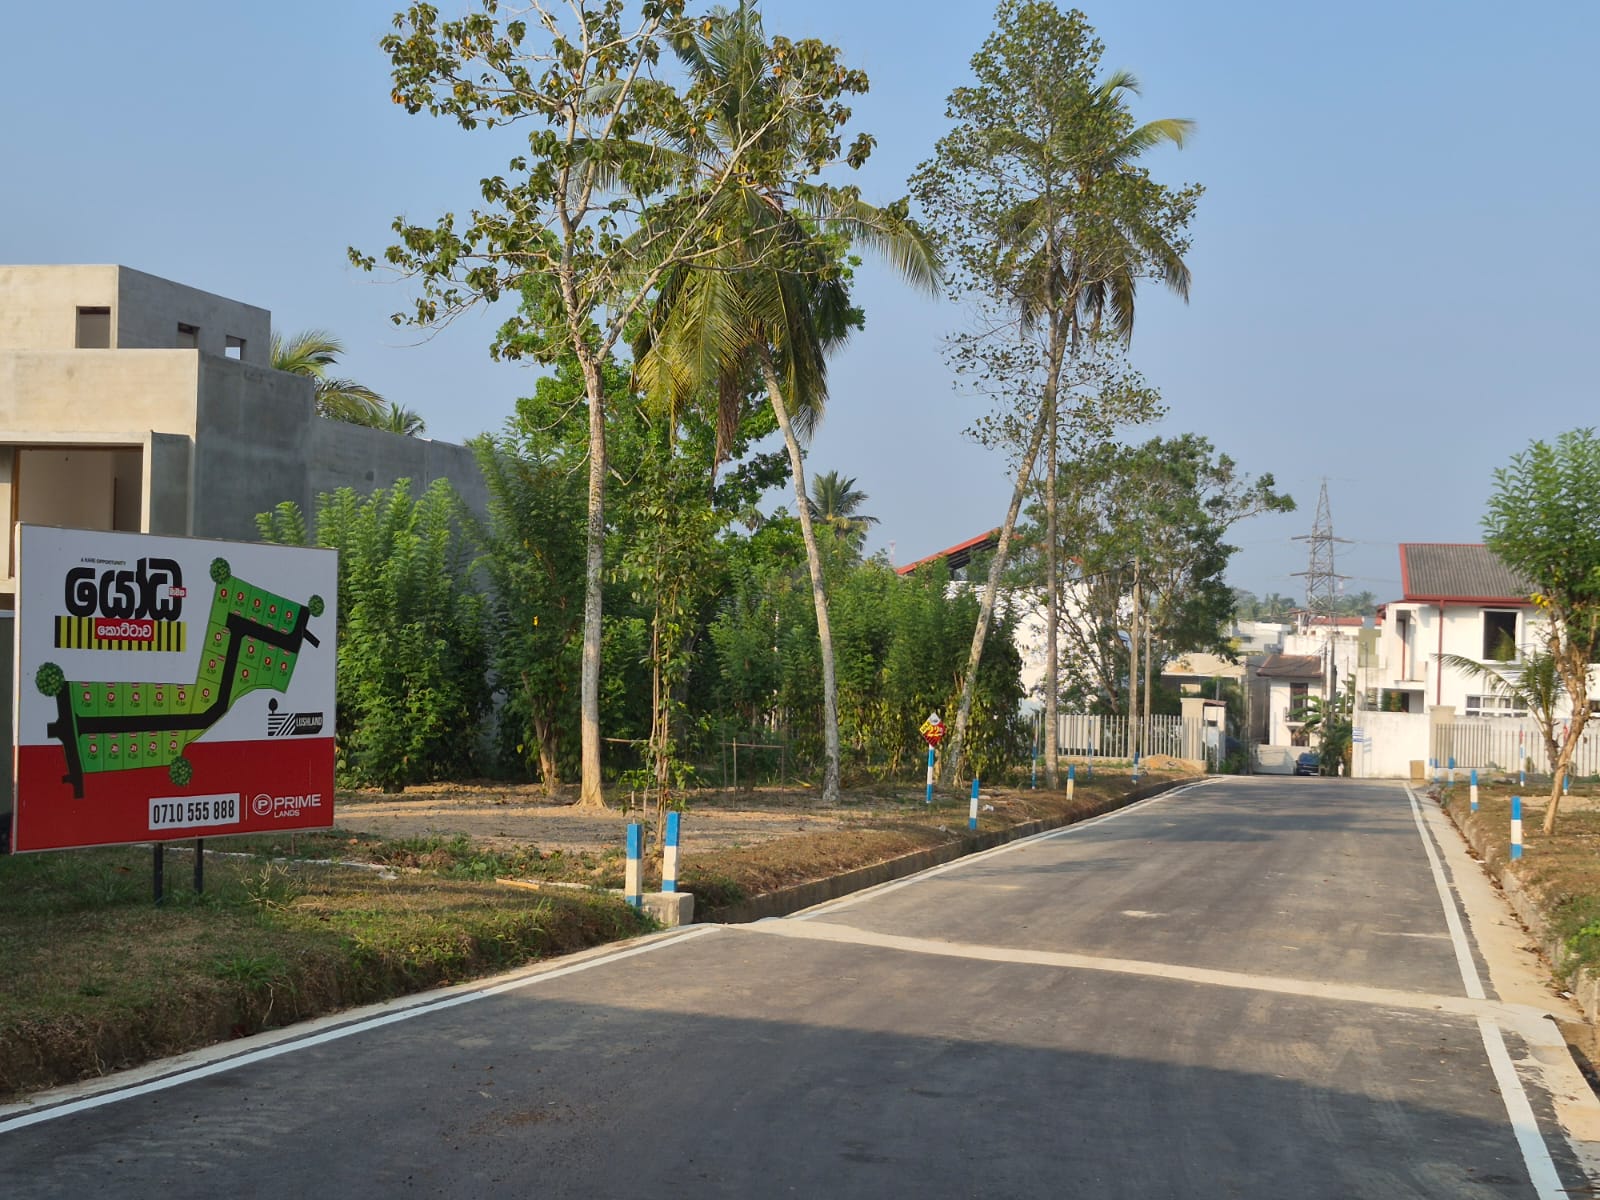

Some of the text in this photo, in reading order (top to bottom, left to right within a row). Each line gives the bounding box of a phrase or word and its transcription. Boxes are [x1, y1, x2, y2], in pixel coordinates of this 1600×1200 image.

[274, 793, 322, 808] PRIME
[153, 799, 235, 824] 0710 555 888
[274, 809, 300, 818] LANDS
